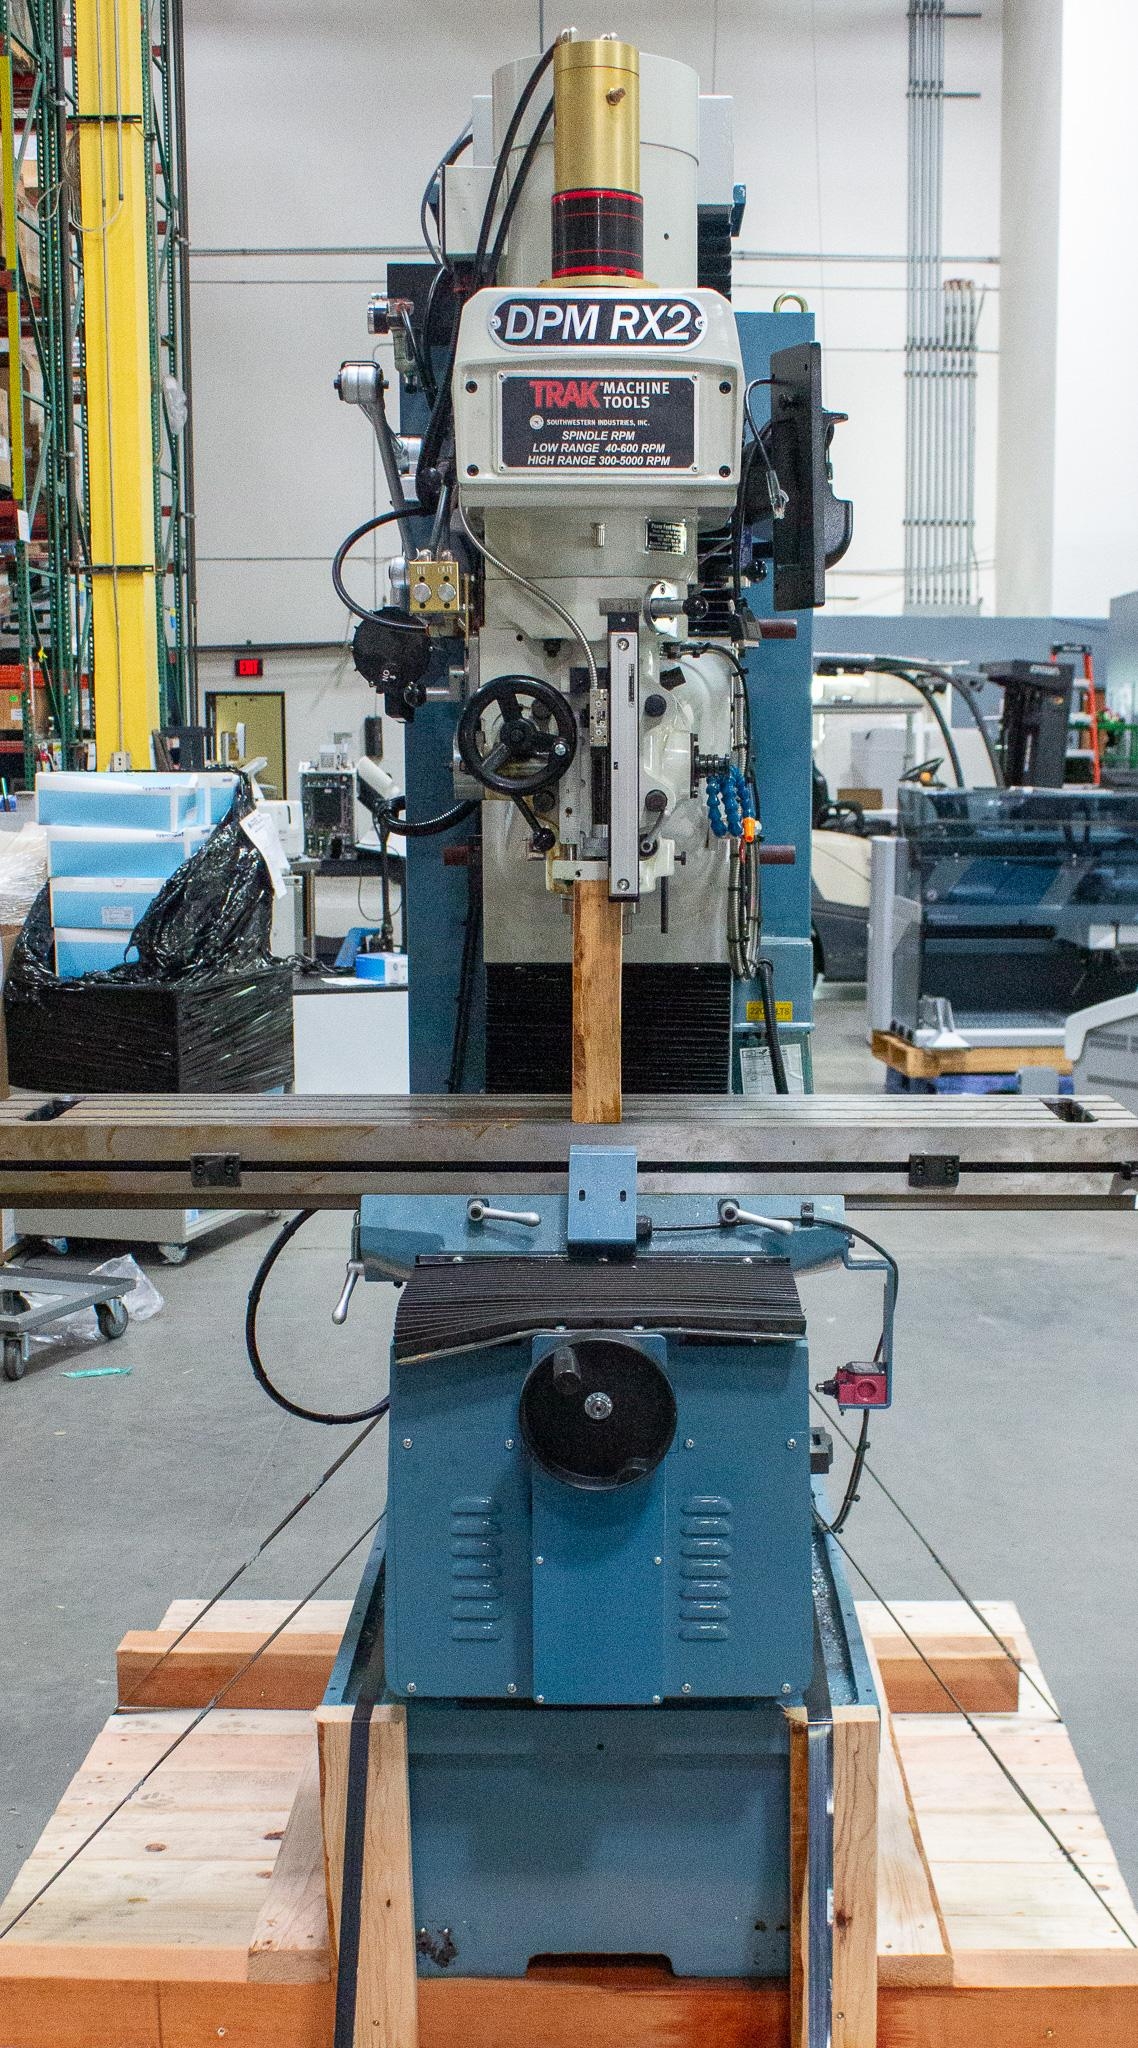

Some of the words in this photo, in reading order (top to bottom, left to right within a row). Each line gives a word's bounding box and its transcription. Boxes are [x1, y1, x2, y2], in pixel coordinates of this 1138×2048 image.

[504, 304, 600, 341] DPM
[609, 304, 693, 341] RX2
[603, 381, 670, 395] MACHINE
[603, 396, 651, 409] TOOLS
[546, 418, 596, 427] SOUTHWESTERN
[597, 418, 636, 427] INDUSTRIES,
[637, 418, 651, 427] INC.
[562, 430, 609, 441] SPINDLE
[610, 430, 636, 441] RPM
[532, 443, 559, 453] LOW
[560, 443, 600, 453] RANGE
[604, 443, 639, 453] 40-600
[640, 443, 666, 453] RPM
[527, 455, 555, 466] HIGH
[556, 455, 597, 466] RANGE
[598, 455, 645, 466] 300-5000
[646, 455, 671, 466] RPM
[437, 566, 454, 575] OUT
